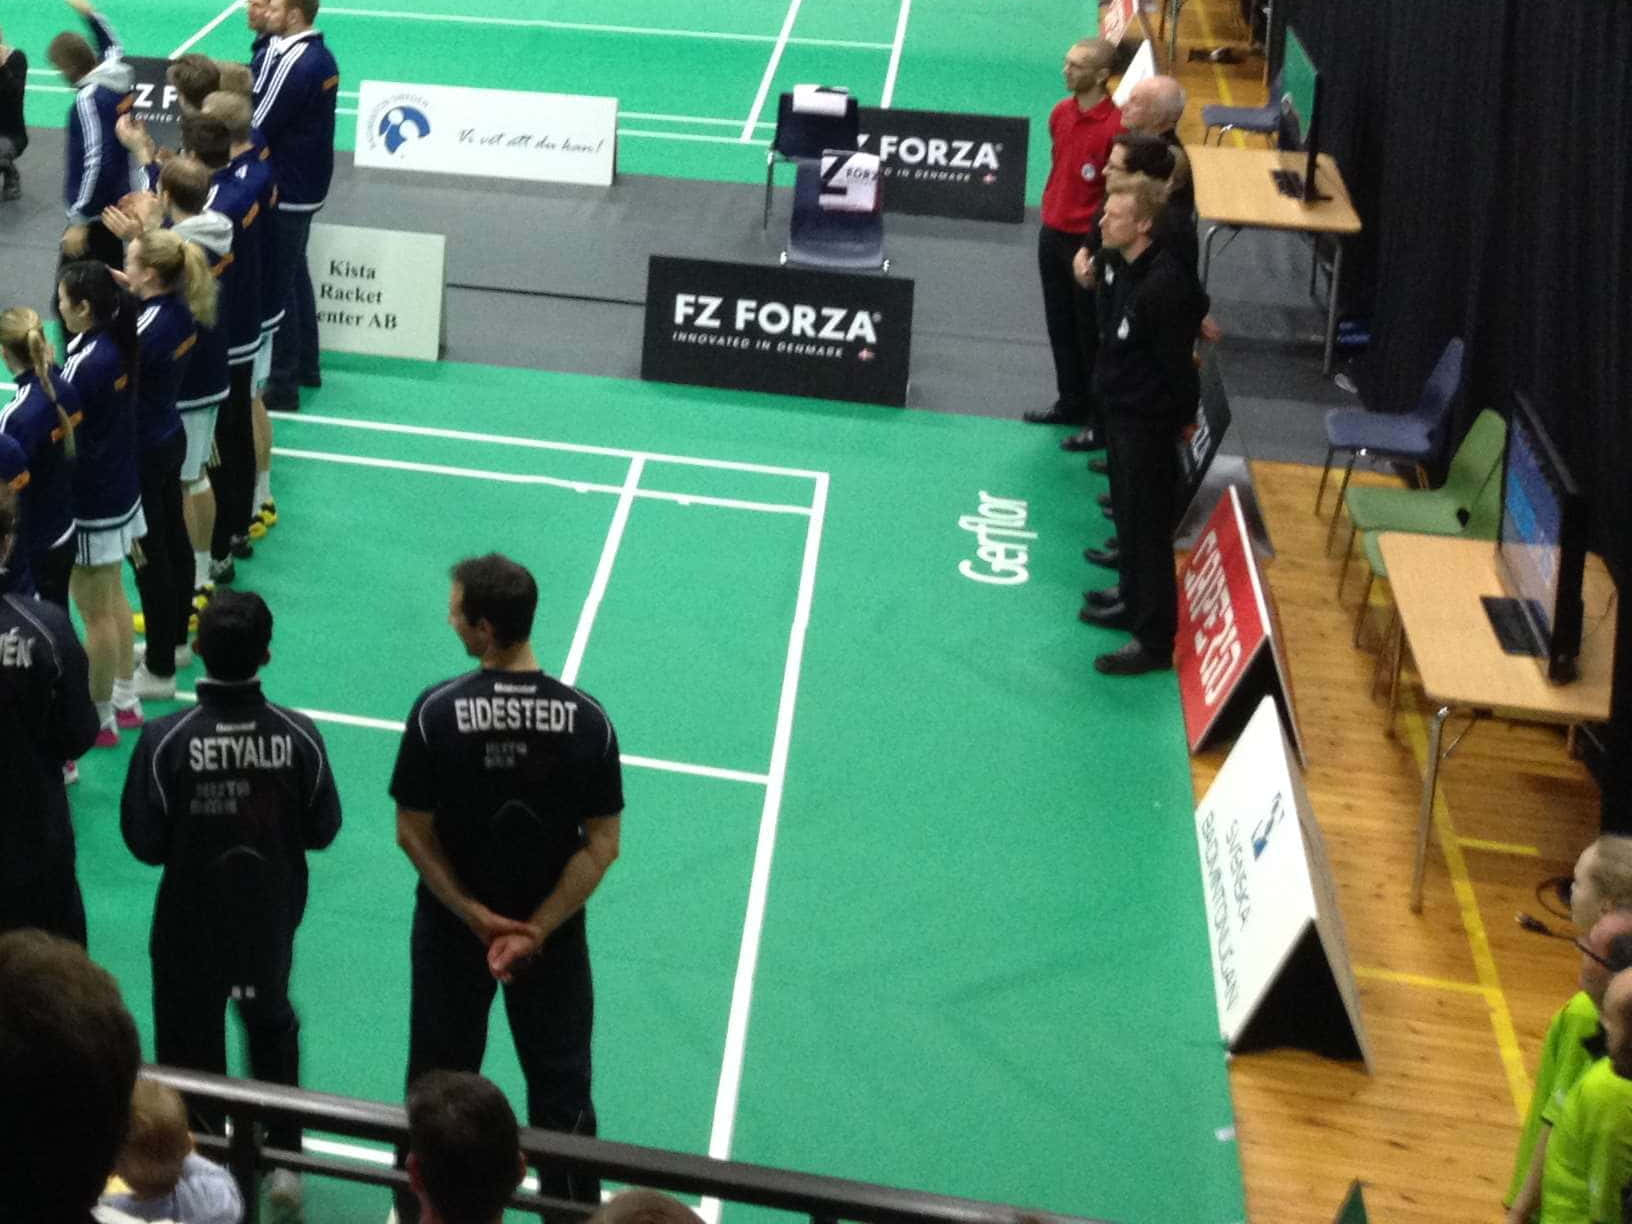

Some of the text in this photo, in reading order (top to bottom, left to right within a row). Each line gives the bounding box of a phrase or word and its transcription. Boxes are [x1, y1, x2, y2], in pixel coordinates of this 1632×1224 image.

[879, 134, 1000, 170] FORZA
[329, 259, 377, 281] Kista
[320, 283, 384, 304] Racket
[318, 310, 398, 330] enter AB
[674, 293, 878, 344] FZ FORZA
[672, 331, 844, 359] INNOVATED IN DENMARK
[957, 489, 1039, 585] Gerflor
[454, 696, 578, 734] EIDESTEDT
[189, 734, 294, 772] SETYALDI
